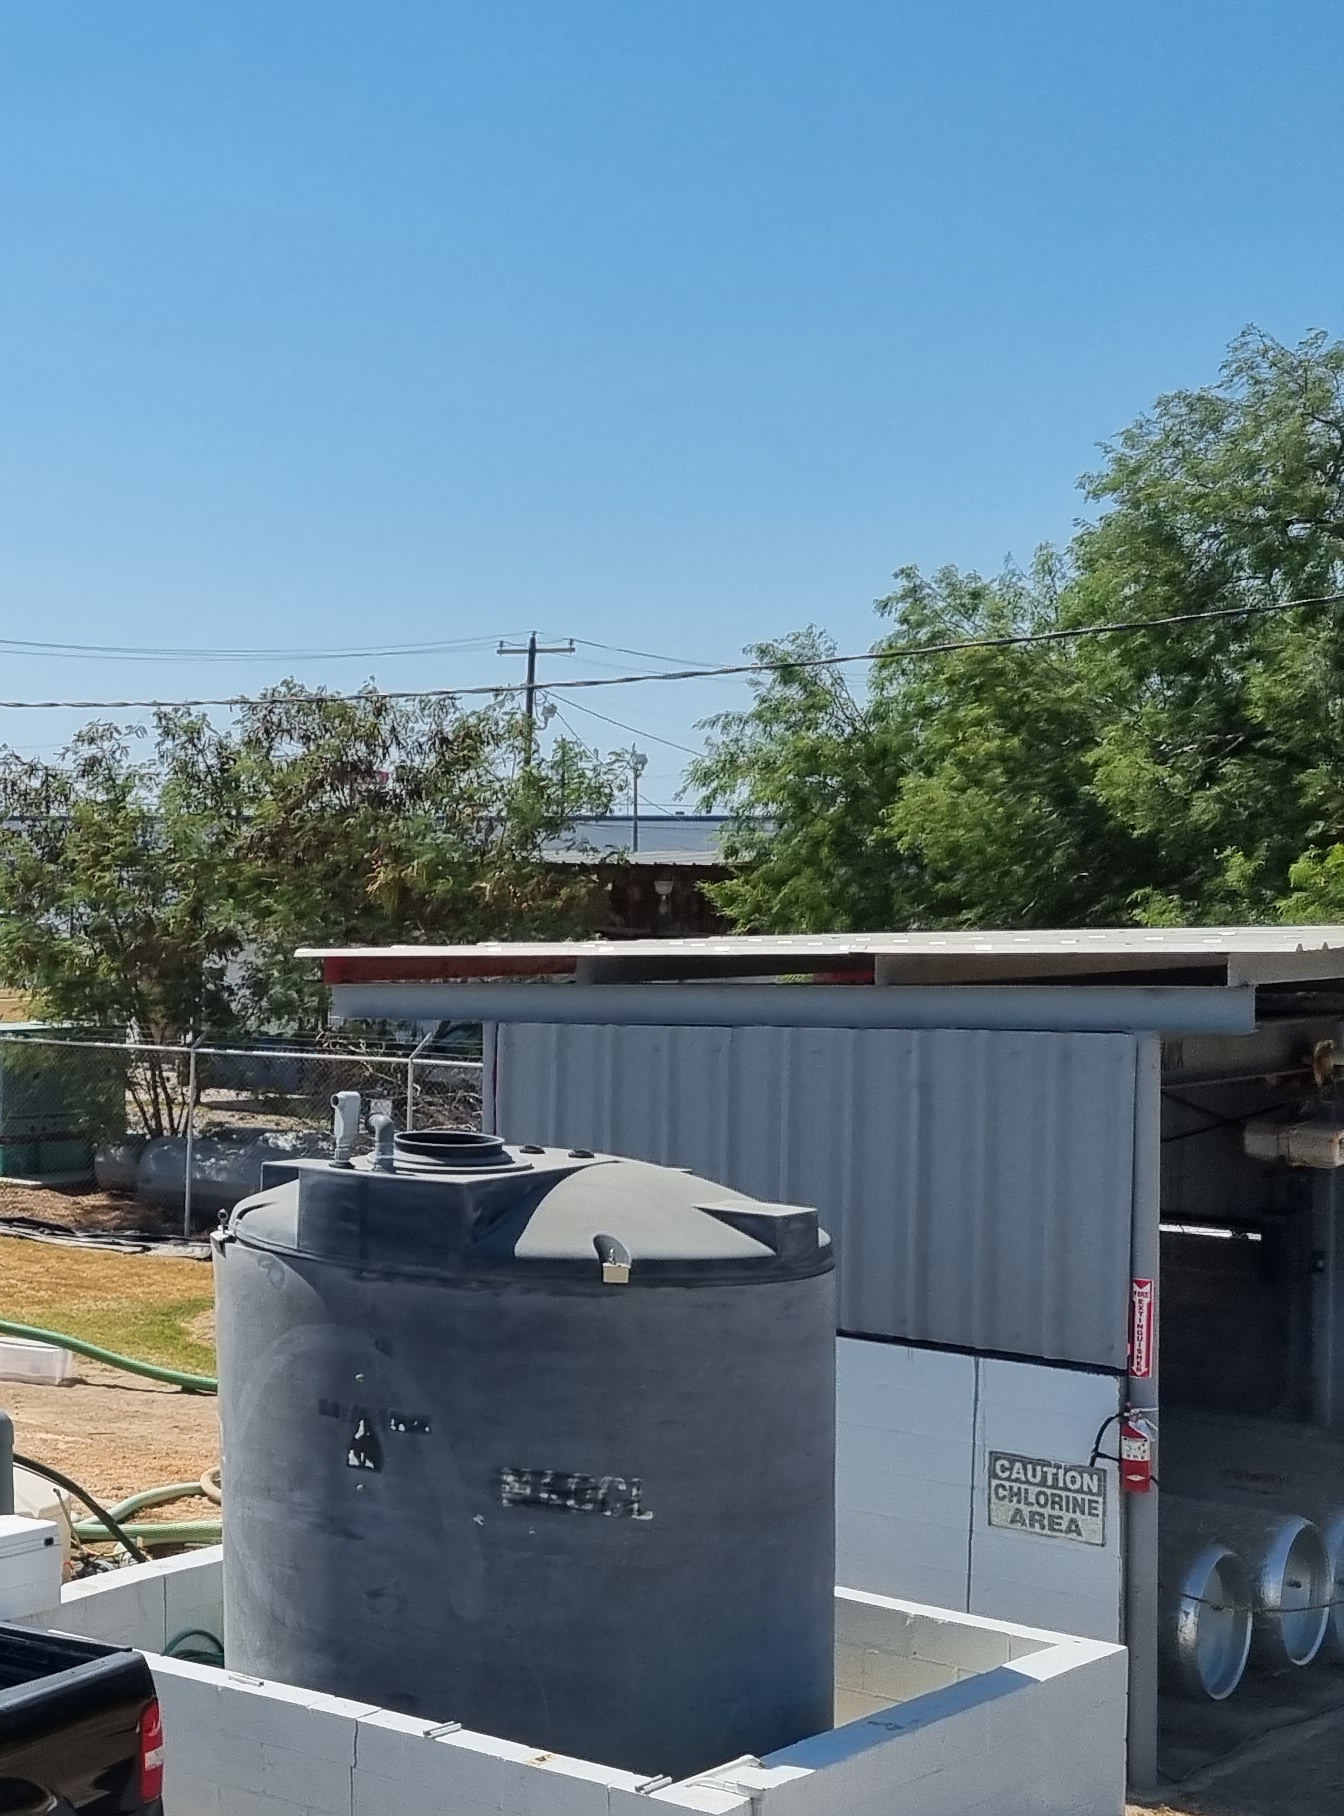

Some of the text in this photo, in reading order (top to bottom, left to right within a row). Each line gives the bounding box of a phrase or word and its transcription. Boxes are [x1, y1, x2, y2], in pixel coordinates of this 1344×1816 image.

[995, 1459, 1099, 1493] CAUTION
[993, 1482, 1100, 1518] CHLORINE
[1009, 1507, 1083, 1538] AREA
